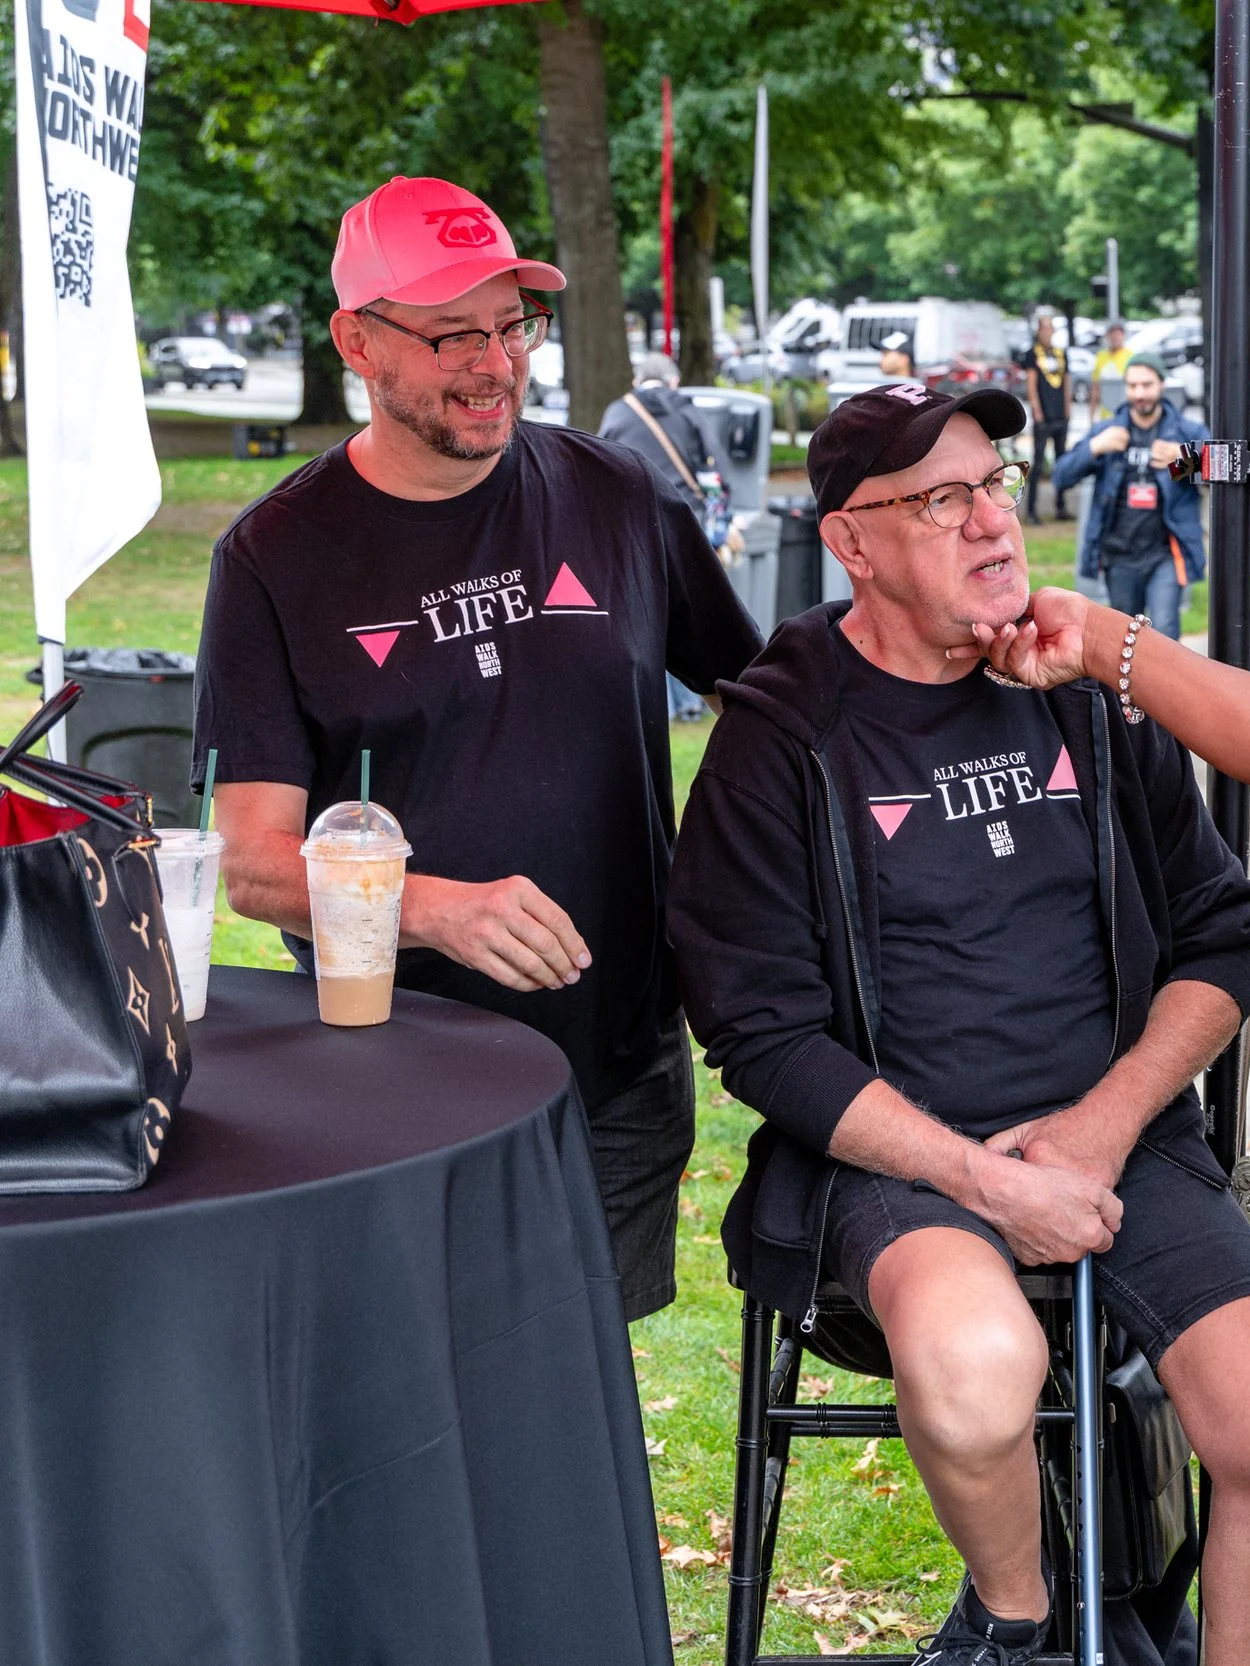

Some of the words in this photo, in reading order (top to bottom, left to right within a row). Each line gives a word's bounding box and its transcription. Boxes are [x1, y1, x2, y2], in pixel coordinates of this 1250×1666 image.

[44, 88, 140, 184] ORTHWE
[420, 589, 451, 608] ALL
[450, 575, 500, 596] WALKS
[500, 569, 522, 585] OF
[423, 584, 534, 643] LIFE
[474, 641, 497, 654] AIDS
[475, 650, 499, 662] WALK
[478, 658, 501, 670] NORTH
[480, 665, 502, 678] WEST
[933, 765, 959, 781] ALL
[958, 754, 1009, 775] WALKS
[1009, 751, 1027, 766] OF
[936, 766, 1043, 821] LIFE
[986, 820, 1008, 834] AIDS
[988, 828, 1011, 841] WALK
[990, 837, 1014, 850] NORTH
[993, 844, 1015, 858] WEST
